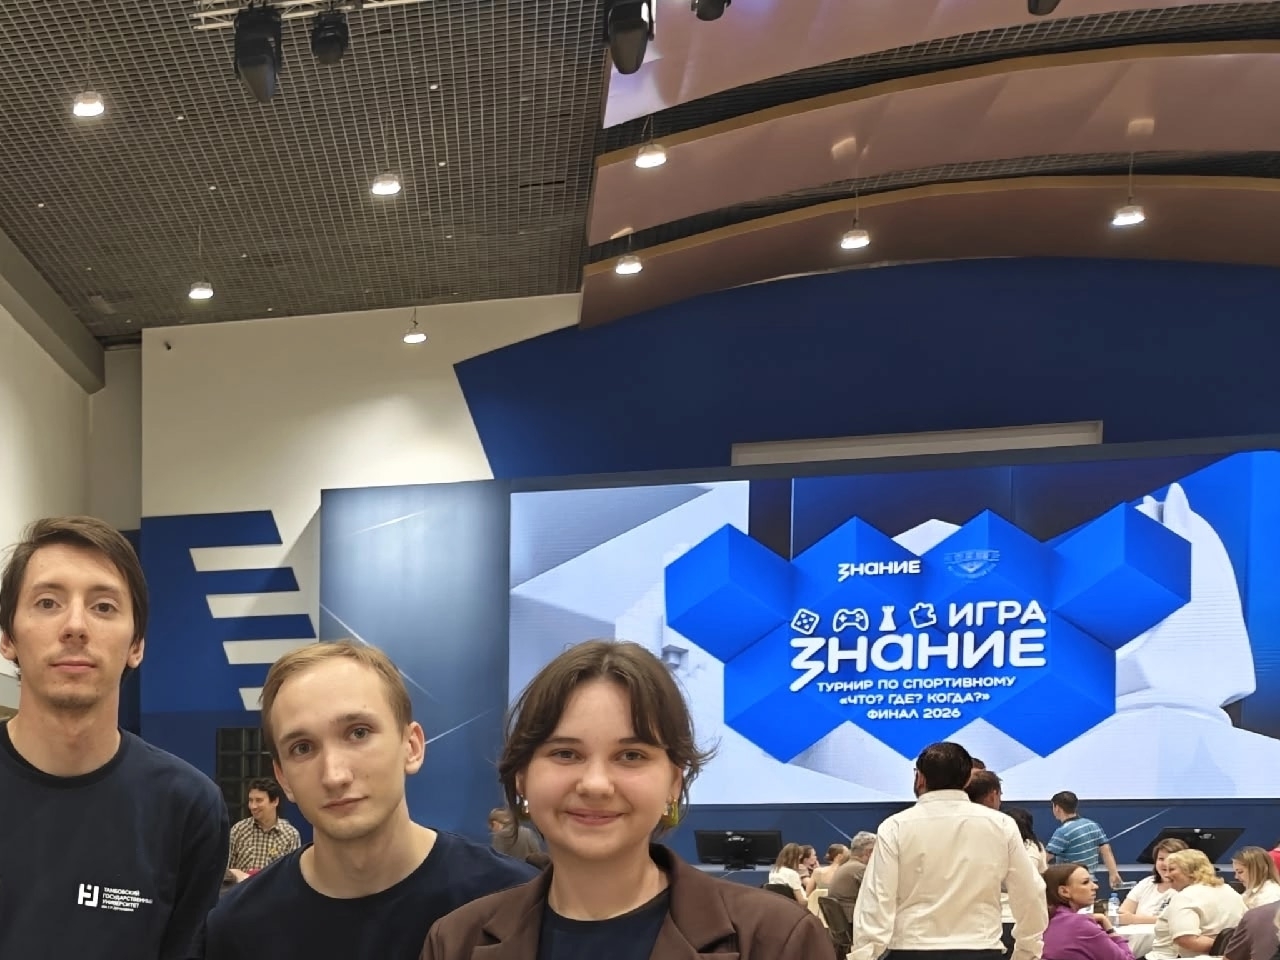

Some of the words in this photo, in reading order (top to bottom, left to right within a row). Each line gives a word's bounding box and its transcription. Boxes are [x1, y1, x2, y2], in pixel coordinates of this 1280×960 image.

[948, 599, 1047, 627] ИГРА
[817, 677, 873, 693] ТУРНИР
[877, 678, 898, 690] ПО
[902, 675, 1017, 690] СПОРТИВНОМУ
[839, 693, 884, 706] «ЧТО?
[888, 692, 923, 706] ГДЕ?
[927, 691, 991, 704] КОГДА?»
[866, 708, 920, 721] ФИНАЛ
[922, 707, 962, 720] 2026
